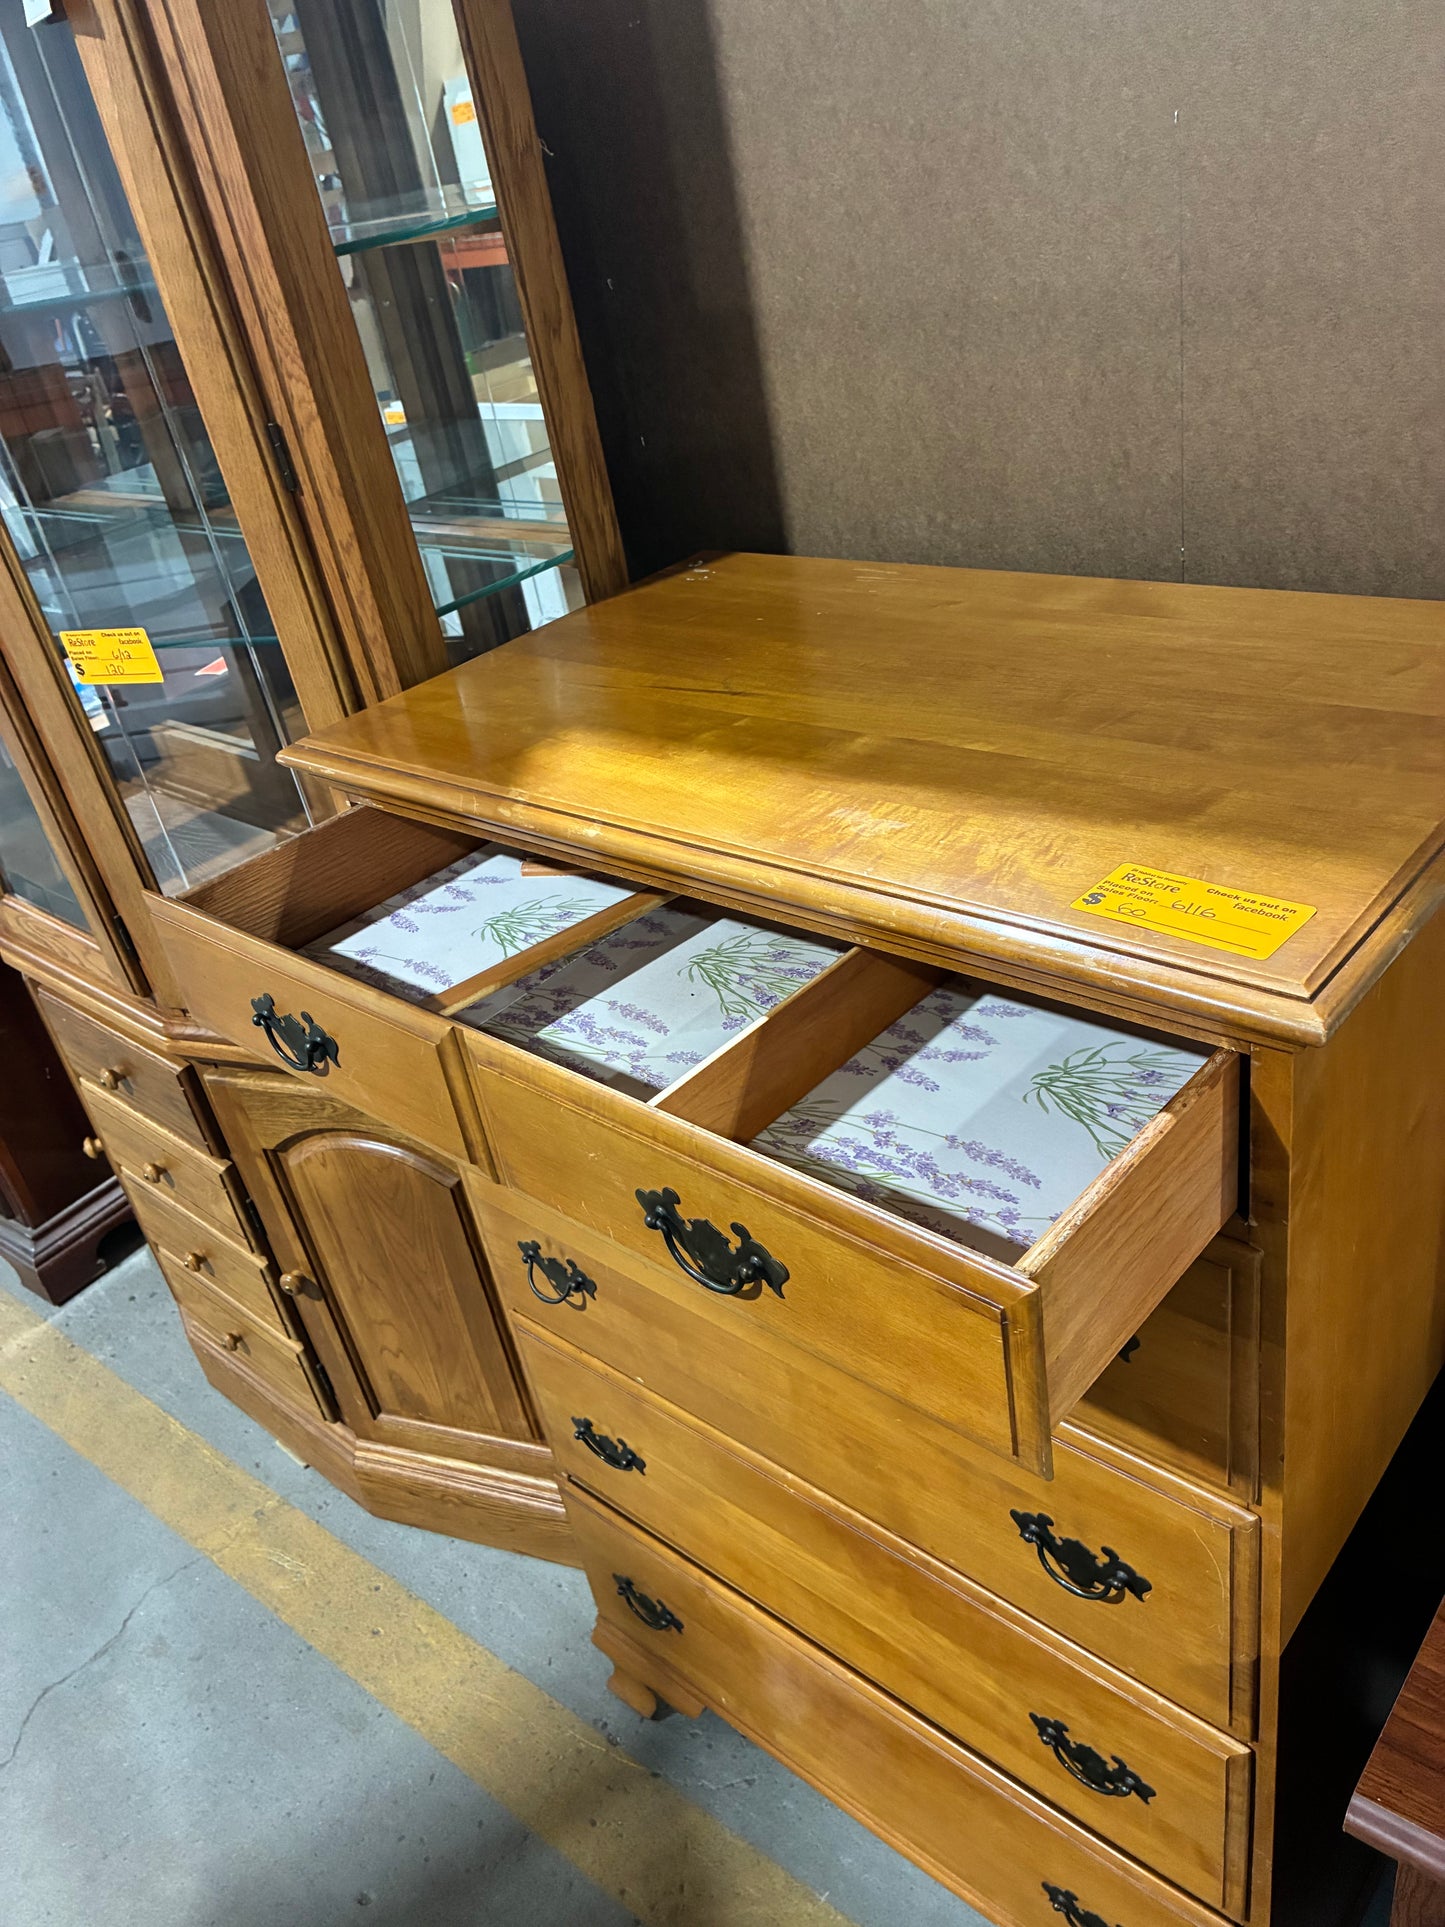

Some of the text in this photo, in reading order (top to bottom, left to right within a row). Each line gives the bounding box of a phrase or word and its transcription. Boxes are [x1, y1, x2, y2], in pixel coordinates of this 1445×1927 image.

[68, 638, 96, 647] ReStore
[75, 662, 86, 676] $
[105, 664, 125, 675] 120
[1097, 884, 1125, 896] Sales
[1102, 880, 1154, 897] Placed on
[1121, 872, 1181, 894] ReStore
[1081, 892, 1107, 906] $
[1206, 888, 1242, 901] Check
[1259, 901, 1280, 911] out
[1281, 906, 1298, 915] on
[1232, 902, 1290, 922] facebook
